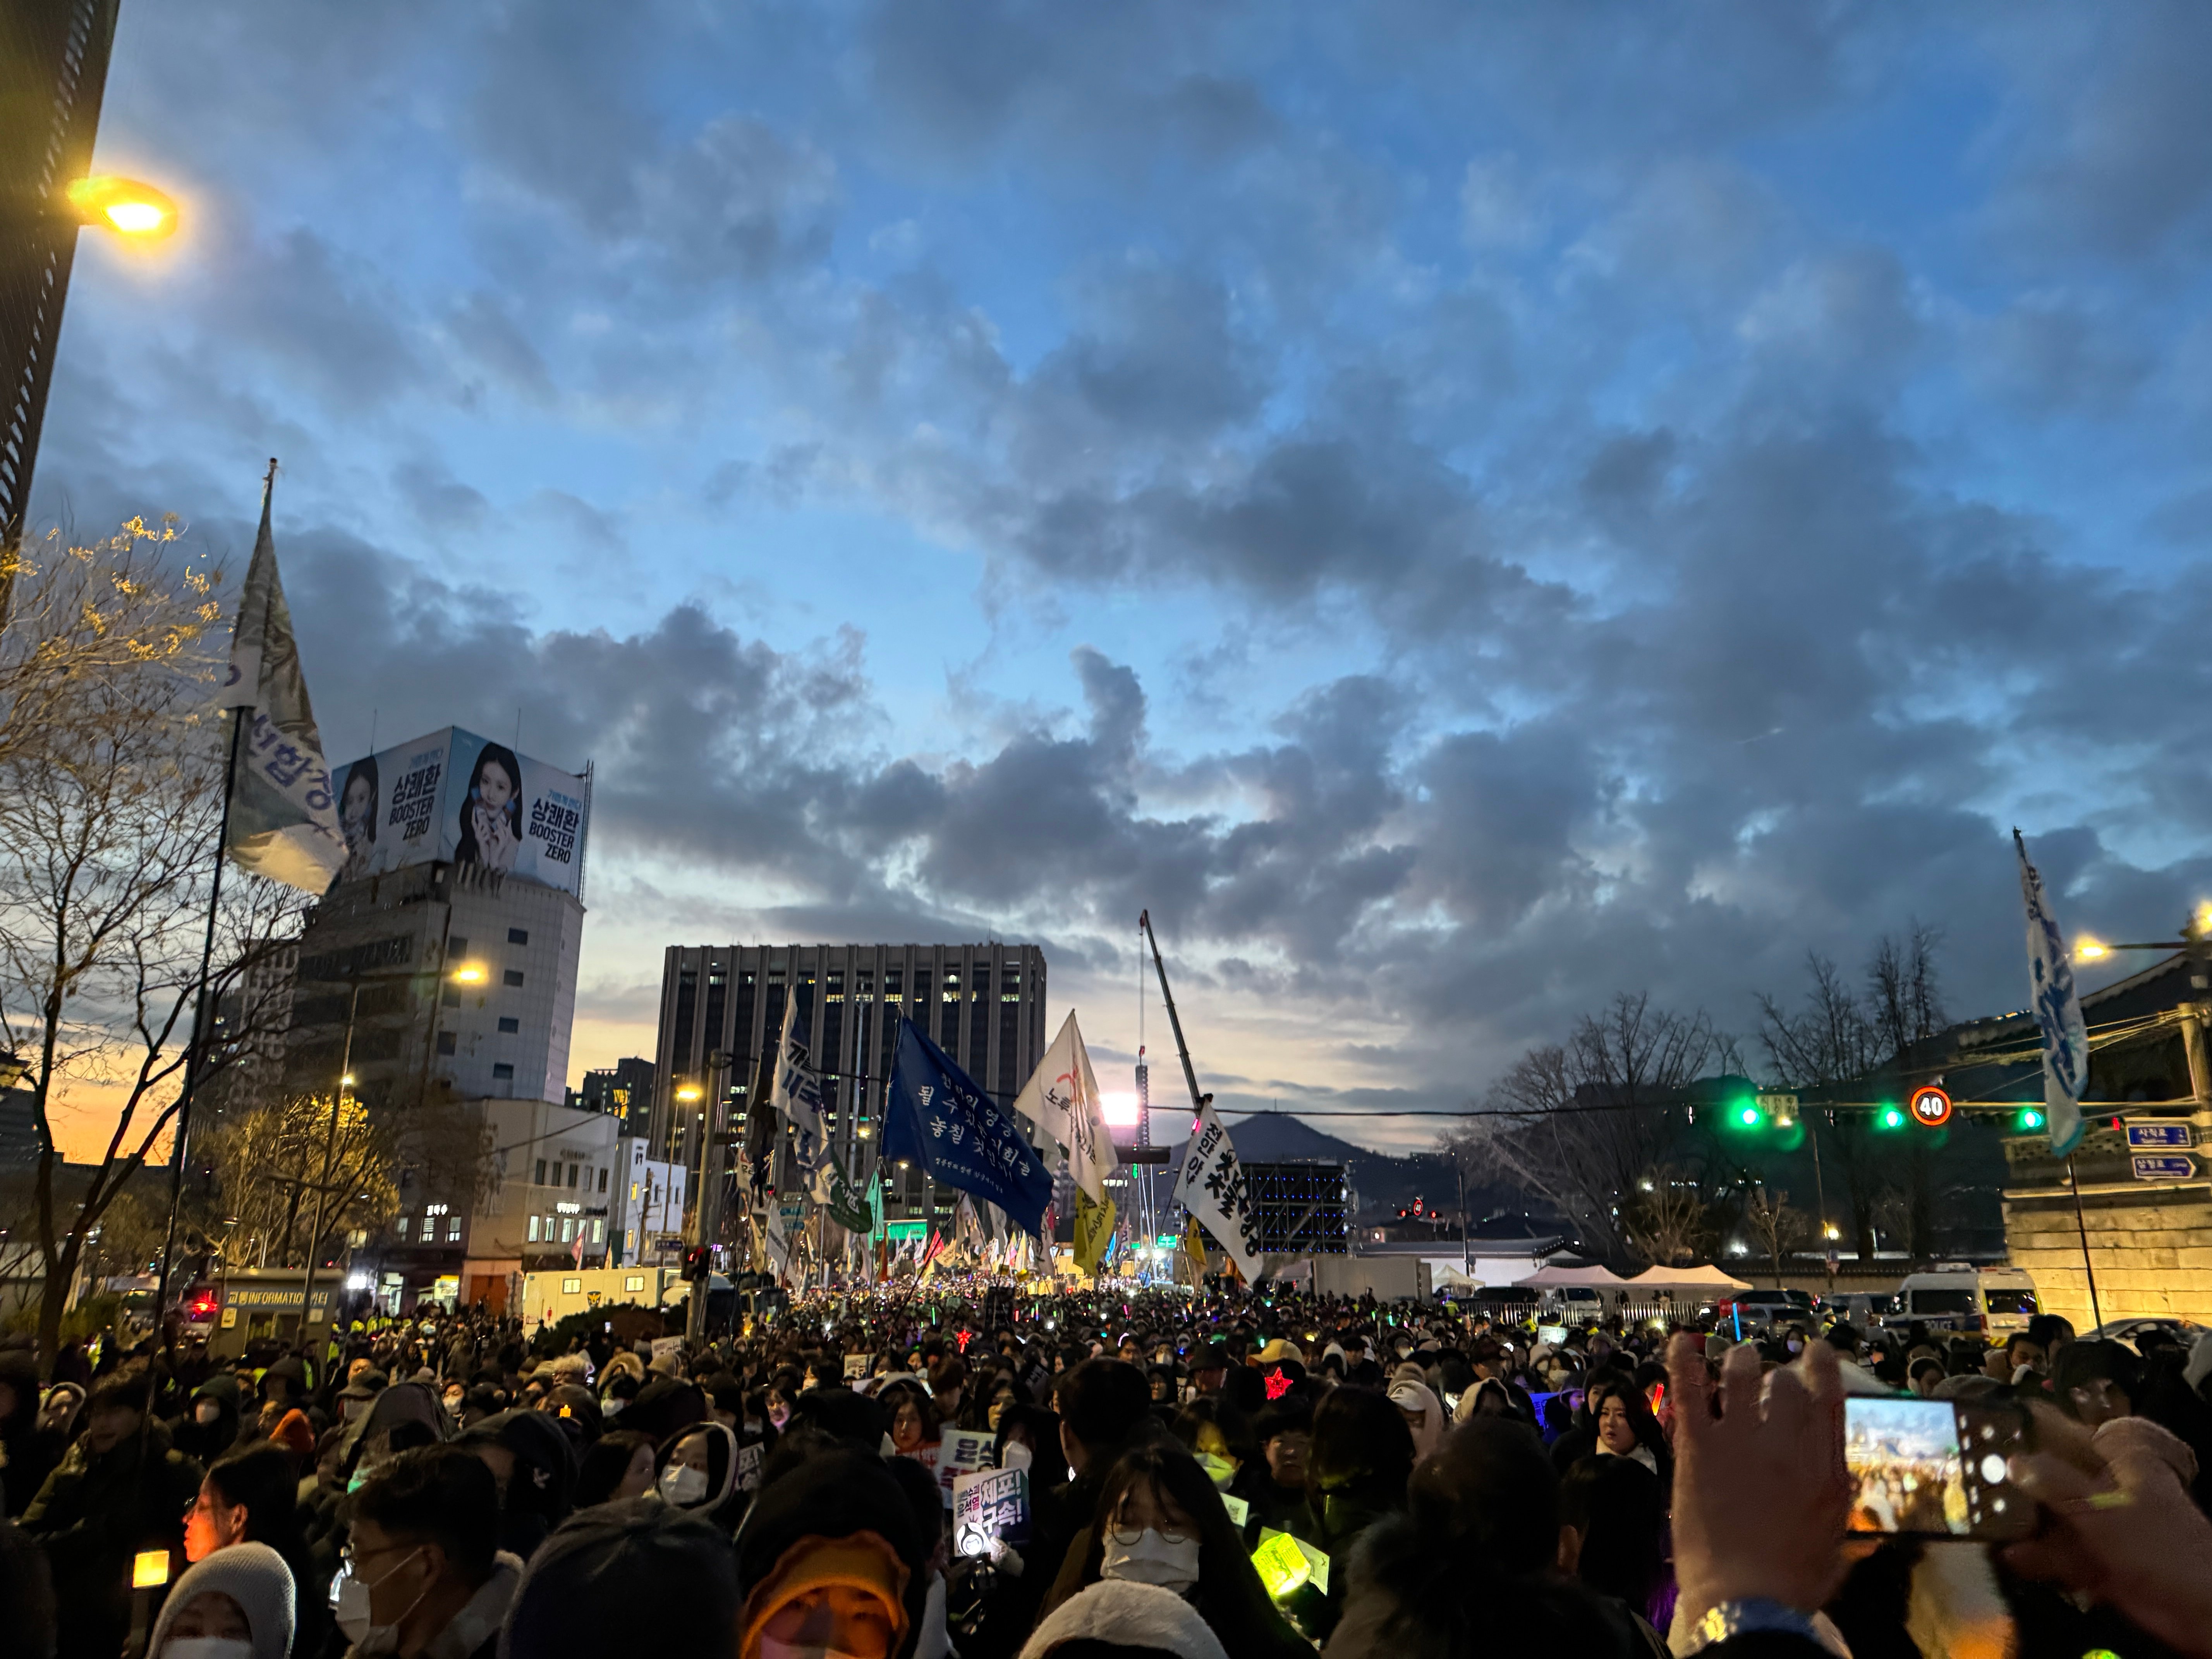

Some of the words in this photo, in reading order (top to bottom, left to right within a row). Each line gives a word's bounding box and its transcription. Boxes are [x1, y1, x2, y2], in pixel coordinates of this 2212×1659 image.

[392, 763, 440, 805] 상쾌환
[389, 795, 434, 826] BOOSTER
[532, 797, 579, 834] 상쾌환
[403, 814, 430, 840] ZERO
[529, 820, 574, 850] BOOSTER
[544, 842, 571, 864] ZERO
[1920, 1097, 1942, 1116] 40
[982, 1470, 1022, 1507] 체포!
[982, 1498, 1022, 1534] 구속!
